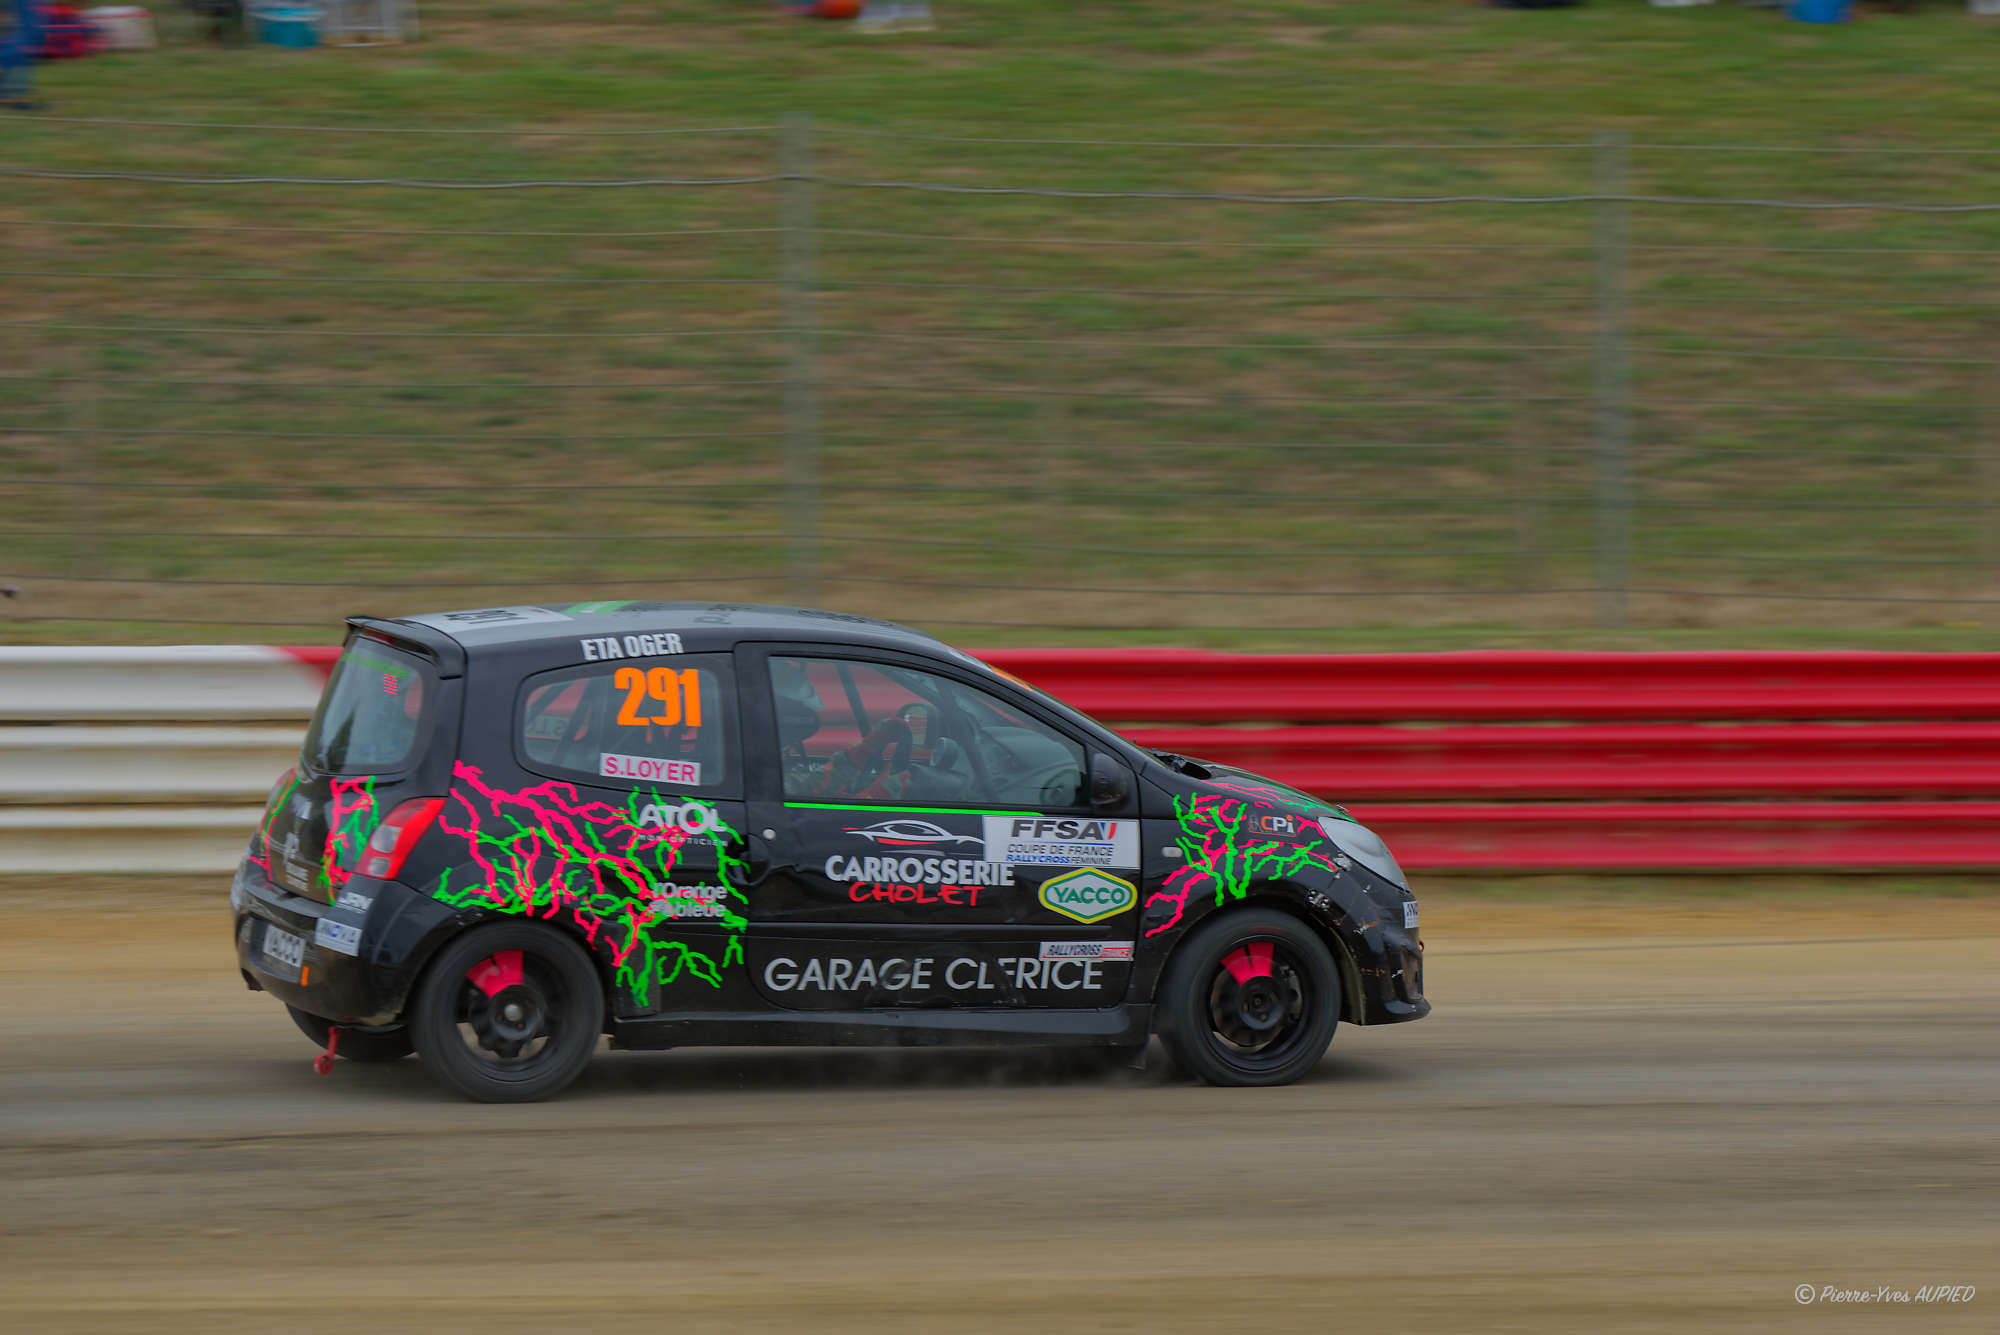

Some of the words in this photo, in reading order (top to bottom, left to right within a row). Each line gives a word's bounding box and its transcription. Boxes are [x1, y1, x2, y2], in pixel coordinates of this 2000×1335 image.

[581, 637, 625, 661] ETA
[624, 633, 684, 657] OGER
[614, 667, 702, 727] 291
[604, 756, 696, 783] S.LOYER
[639, 802, 728, 835] ATOL
[1011, 819, 1104, 841] FFSA
[1006, 854, 1070, 863] RALLYCROSS
[1007, 843, 1047, 854] COUPE
[1050, 845, 1065, 855] DE
[1069, 845, 1113, 857] FRANCE
[824, 855, 1015, 887] CARROSSERIE
[848, 881, 985, 906] CHOLET
[1053, 886, 1126, 905] YACCO
[764, 957, 934, 990] GARAGE
